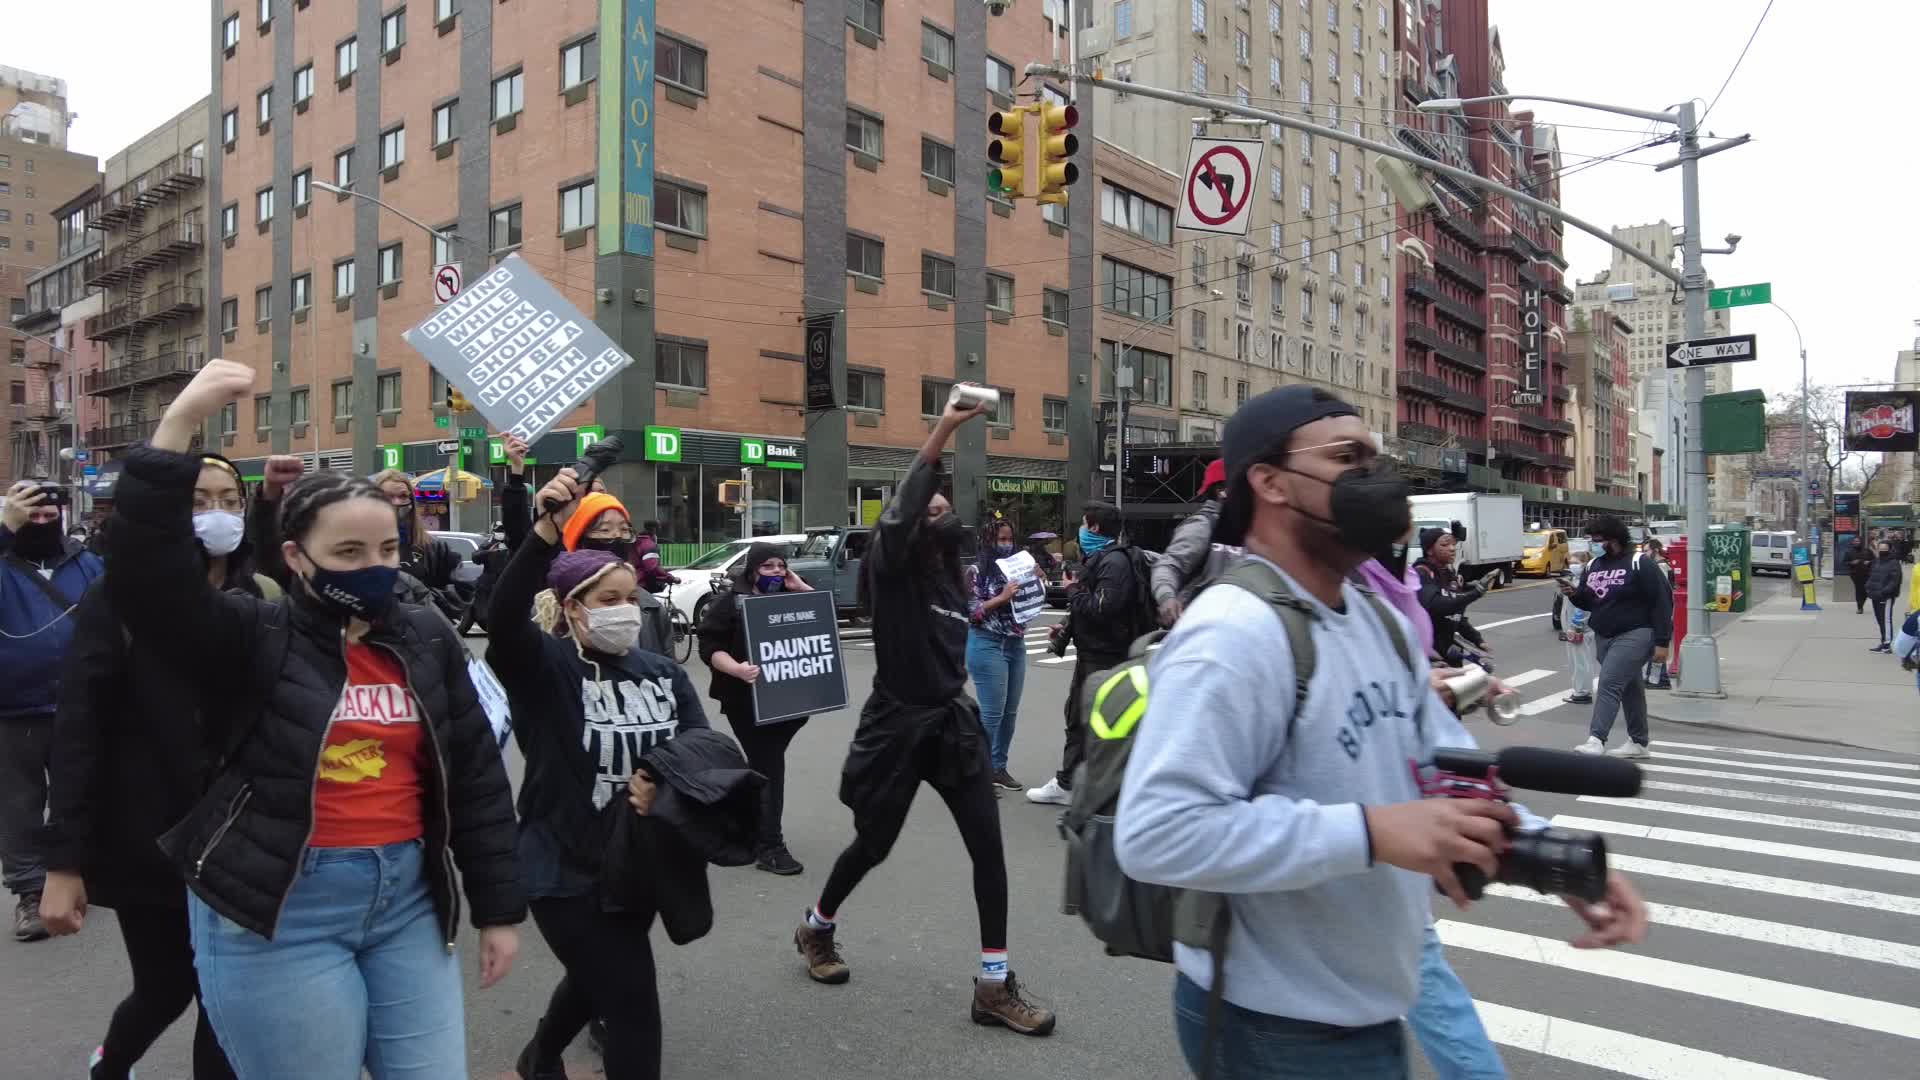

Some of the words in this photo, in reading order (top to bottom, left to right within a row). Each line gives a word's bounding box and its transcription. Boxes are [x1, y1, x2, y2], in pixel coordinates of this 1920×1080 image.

[631, 0, 649, 168] AVOY
[626, 191, 653, 228] HOTEL
[423, 269, 512, 337] DRIVING
[447, 290, 517, 345] WHILE
[1724, 289, 1733, 305] 7
[462, 303, 536, 361] BLACK
[470, 312, 558, 384] SHOULD
[1525, 290, 1539, 391] HOTEL
[1678, 348, 1703, 360] ONE
[1715, 343, 1744, 356] WAY
[480, 363, 529, 406] NOT
[529, 337, 561, 366] BE
[564, 323, 581, 340] A
[511, 348, 585, 412] DEATH
[512, 350, 621, 441] SENTENCE
[651, 432, 678, 455] TD
[744, 443, 762, 459] TD
[767, 445, 797, 457] Bank
[992, 478, 1021, 493] Chelsea
[768, 613, 782, 624] SAY
[783, 612, 795, 623] HIS
[796, 610, 817, 621] NAME
[760, 634, 833, 662] DAUNTE
[761, 654, 834, 683] WRIGHT
